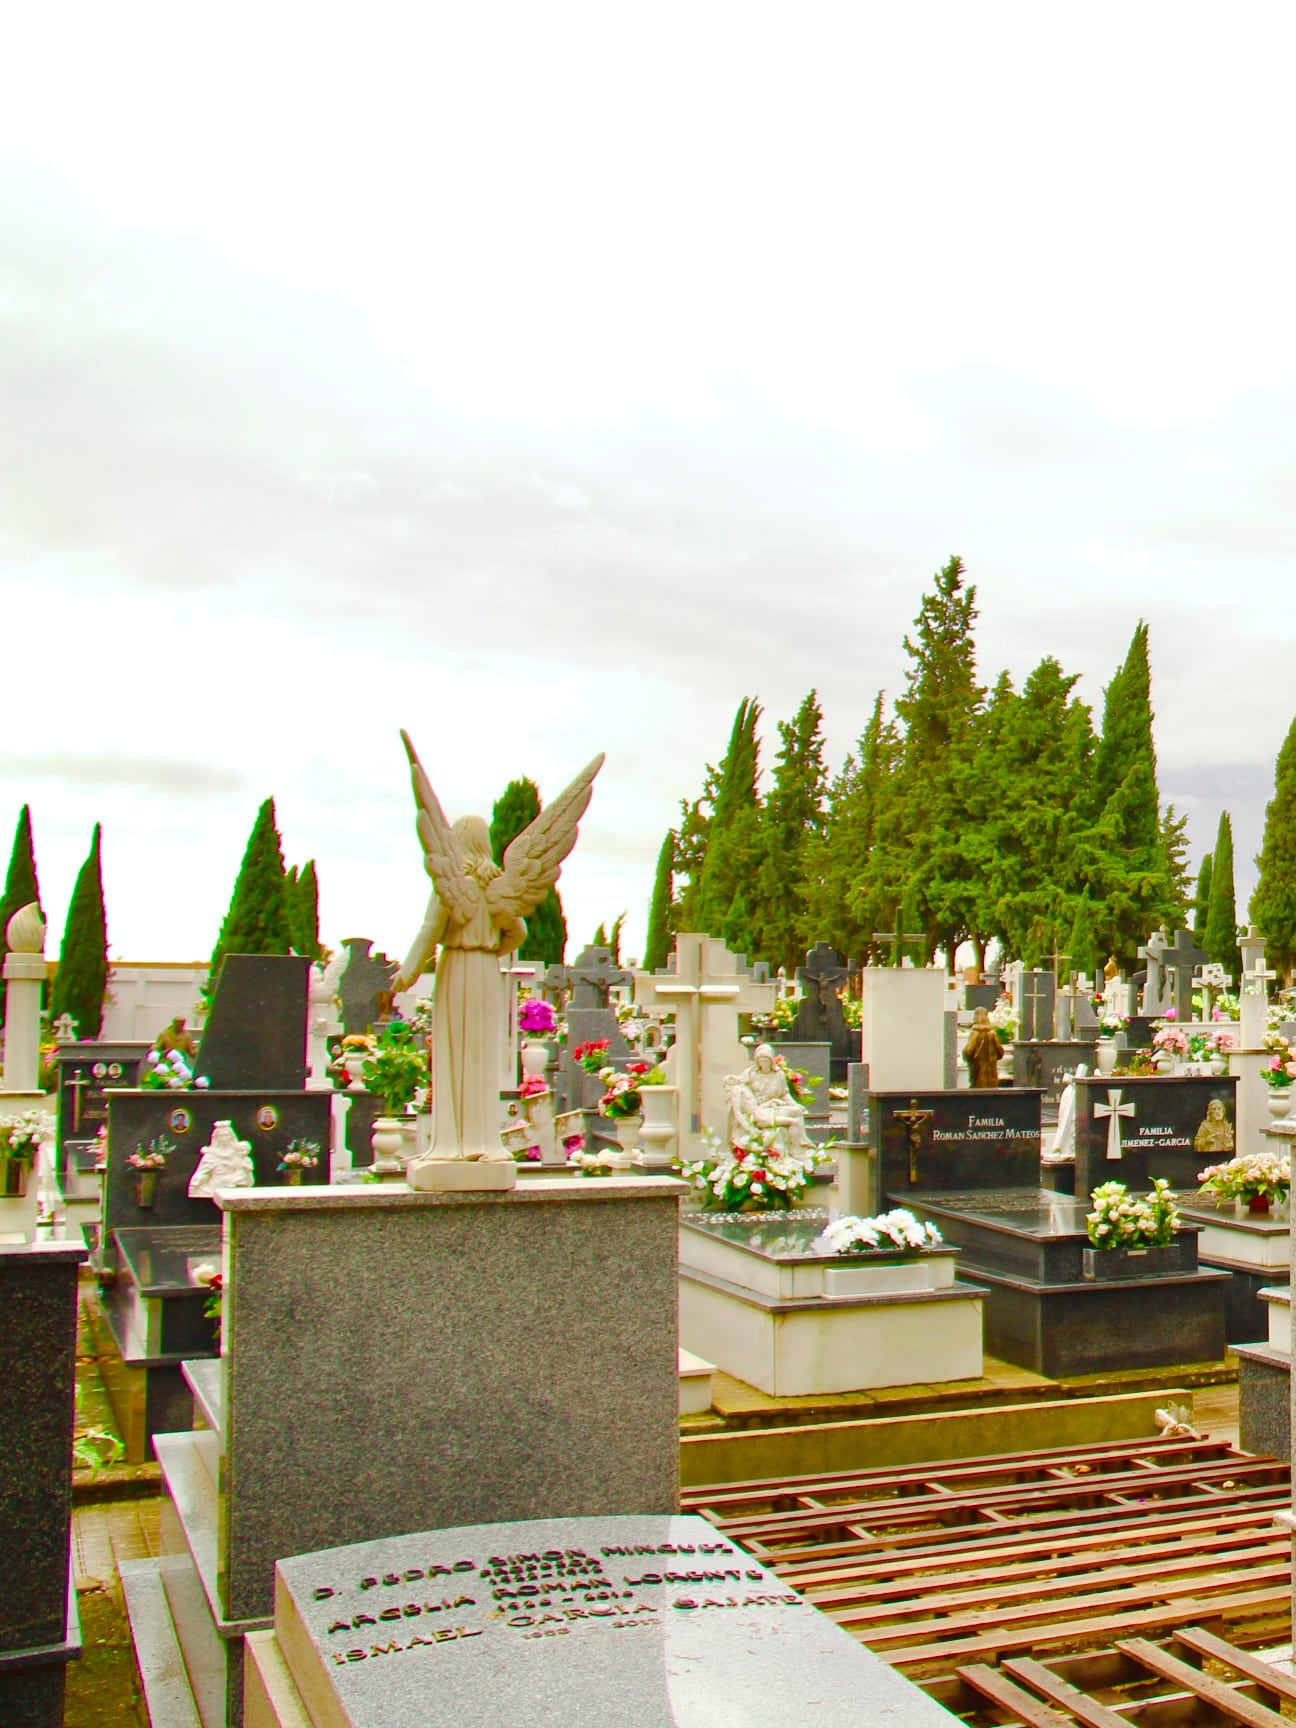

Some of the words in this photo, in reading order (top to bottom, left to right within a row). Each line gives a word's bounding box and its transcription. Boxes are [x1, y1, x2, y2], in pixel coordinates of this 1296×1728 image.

[968, 1115, 1005, 1127] FAMILIA
[932, 1129, 965, 1141] ROMAN
[966, 1129, 1004, 1140] SANCHEZ
[1005, 1128, 1040, 1139] MATEOS
[1139, 1127, 1173, 1136] FAMILIA
[1121, 1137, 1191, 1148] JIMENEZ-GARCIA
[360, 1560, 477, 1591] PEDRO
[327, 1595, 477, 1634] ARGELIA
[491, 1576, 613, 1601] ROMAN
[331, 1626, 485, 1666] ISMAEL
